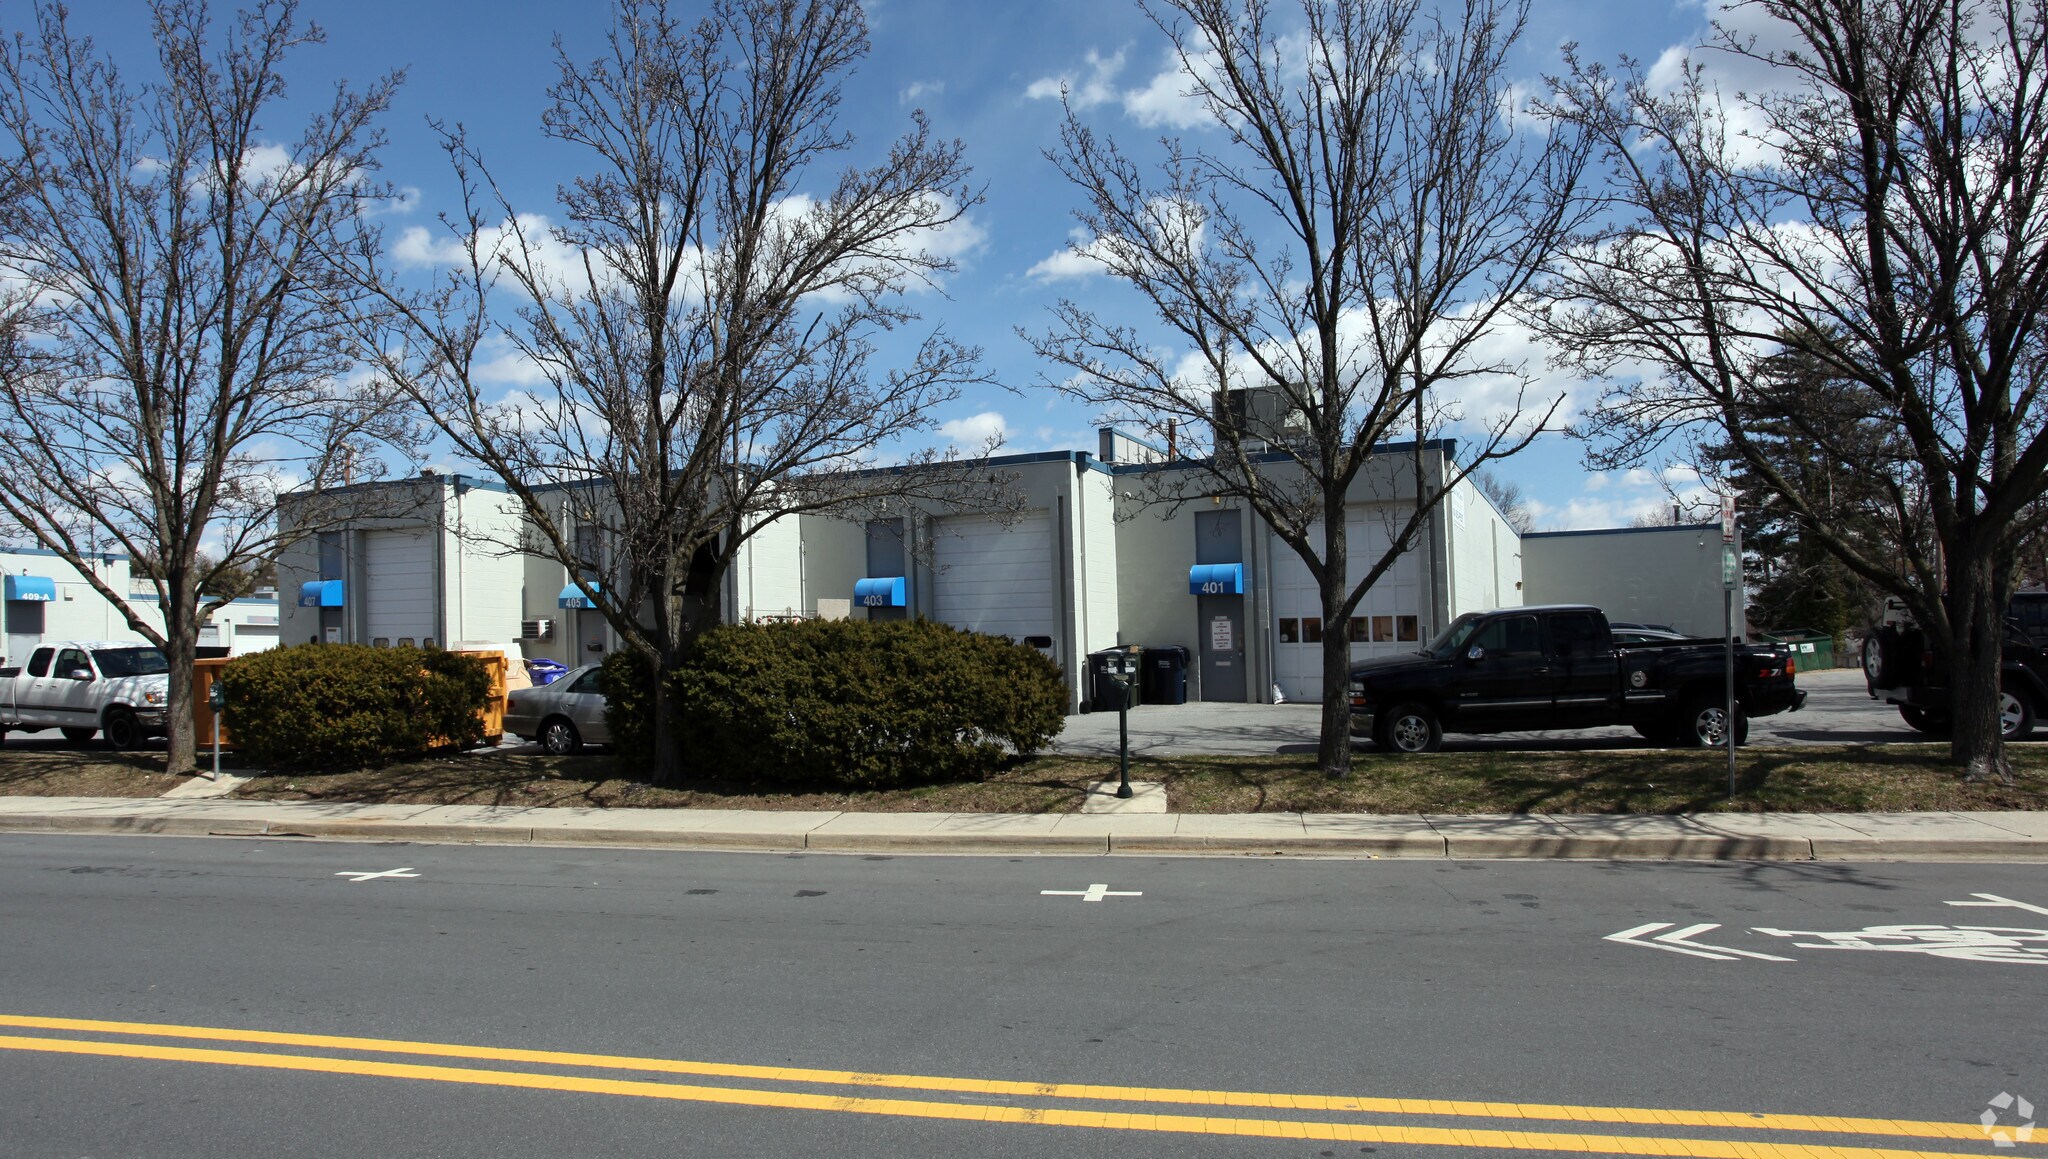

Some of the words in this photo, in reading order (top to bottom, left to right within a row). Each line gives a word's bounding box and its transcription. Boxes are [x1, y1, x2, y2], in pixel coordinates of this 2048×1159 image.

[1201, 581, 1224, 594] 401
[22, 593, 51, 601] 409-A
[303, 596, 316, 607] 407
[565, 597, 581, 608] 405
[863, 594, 883, 606] 403
